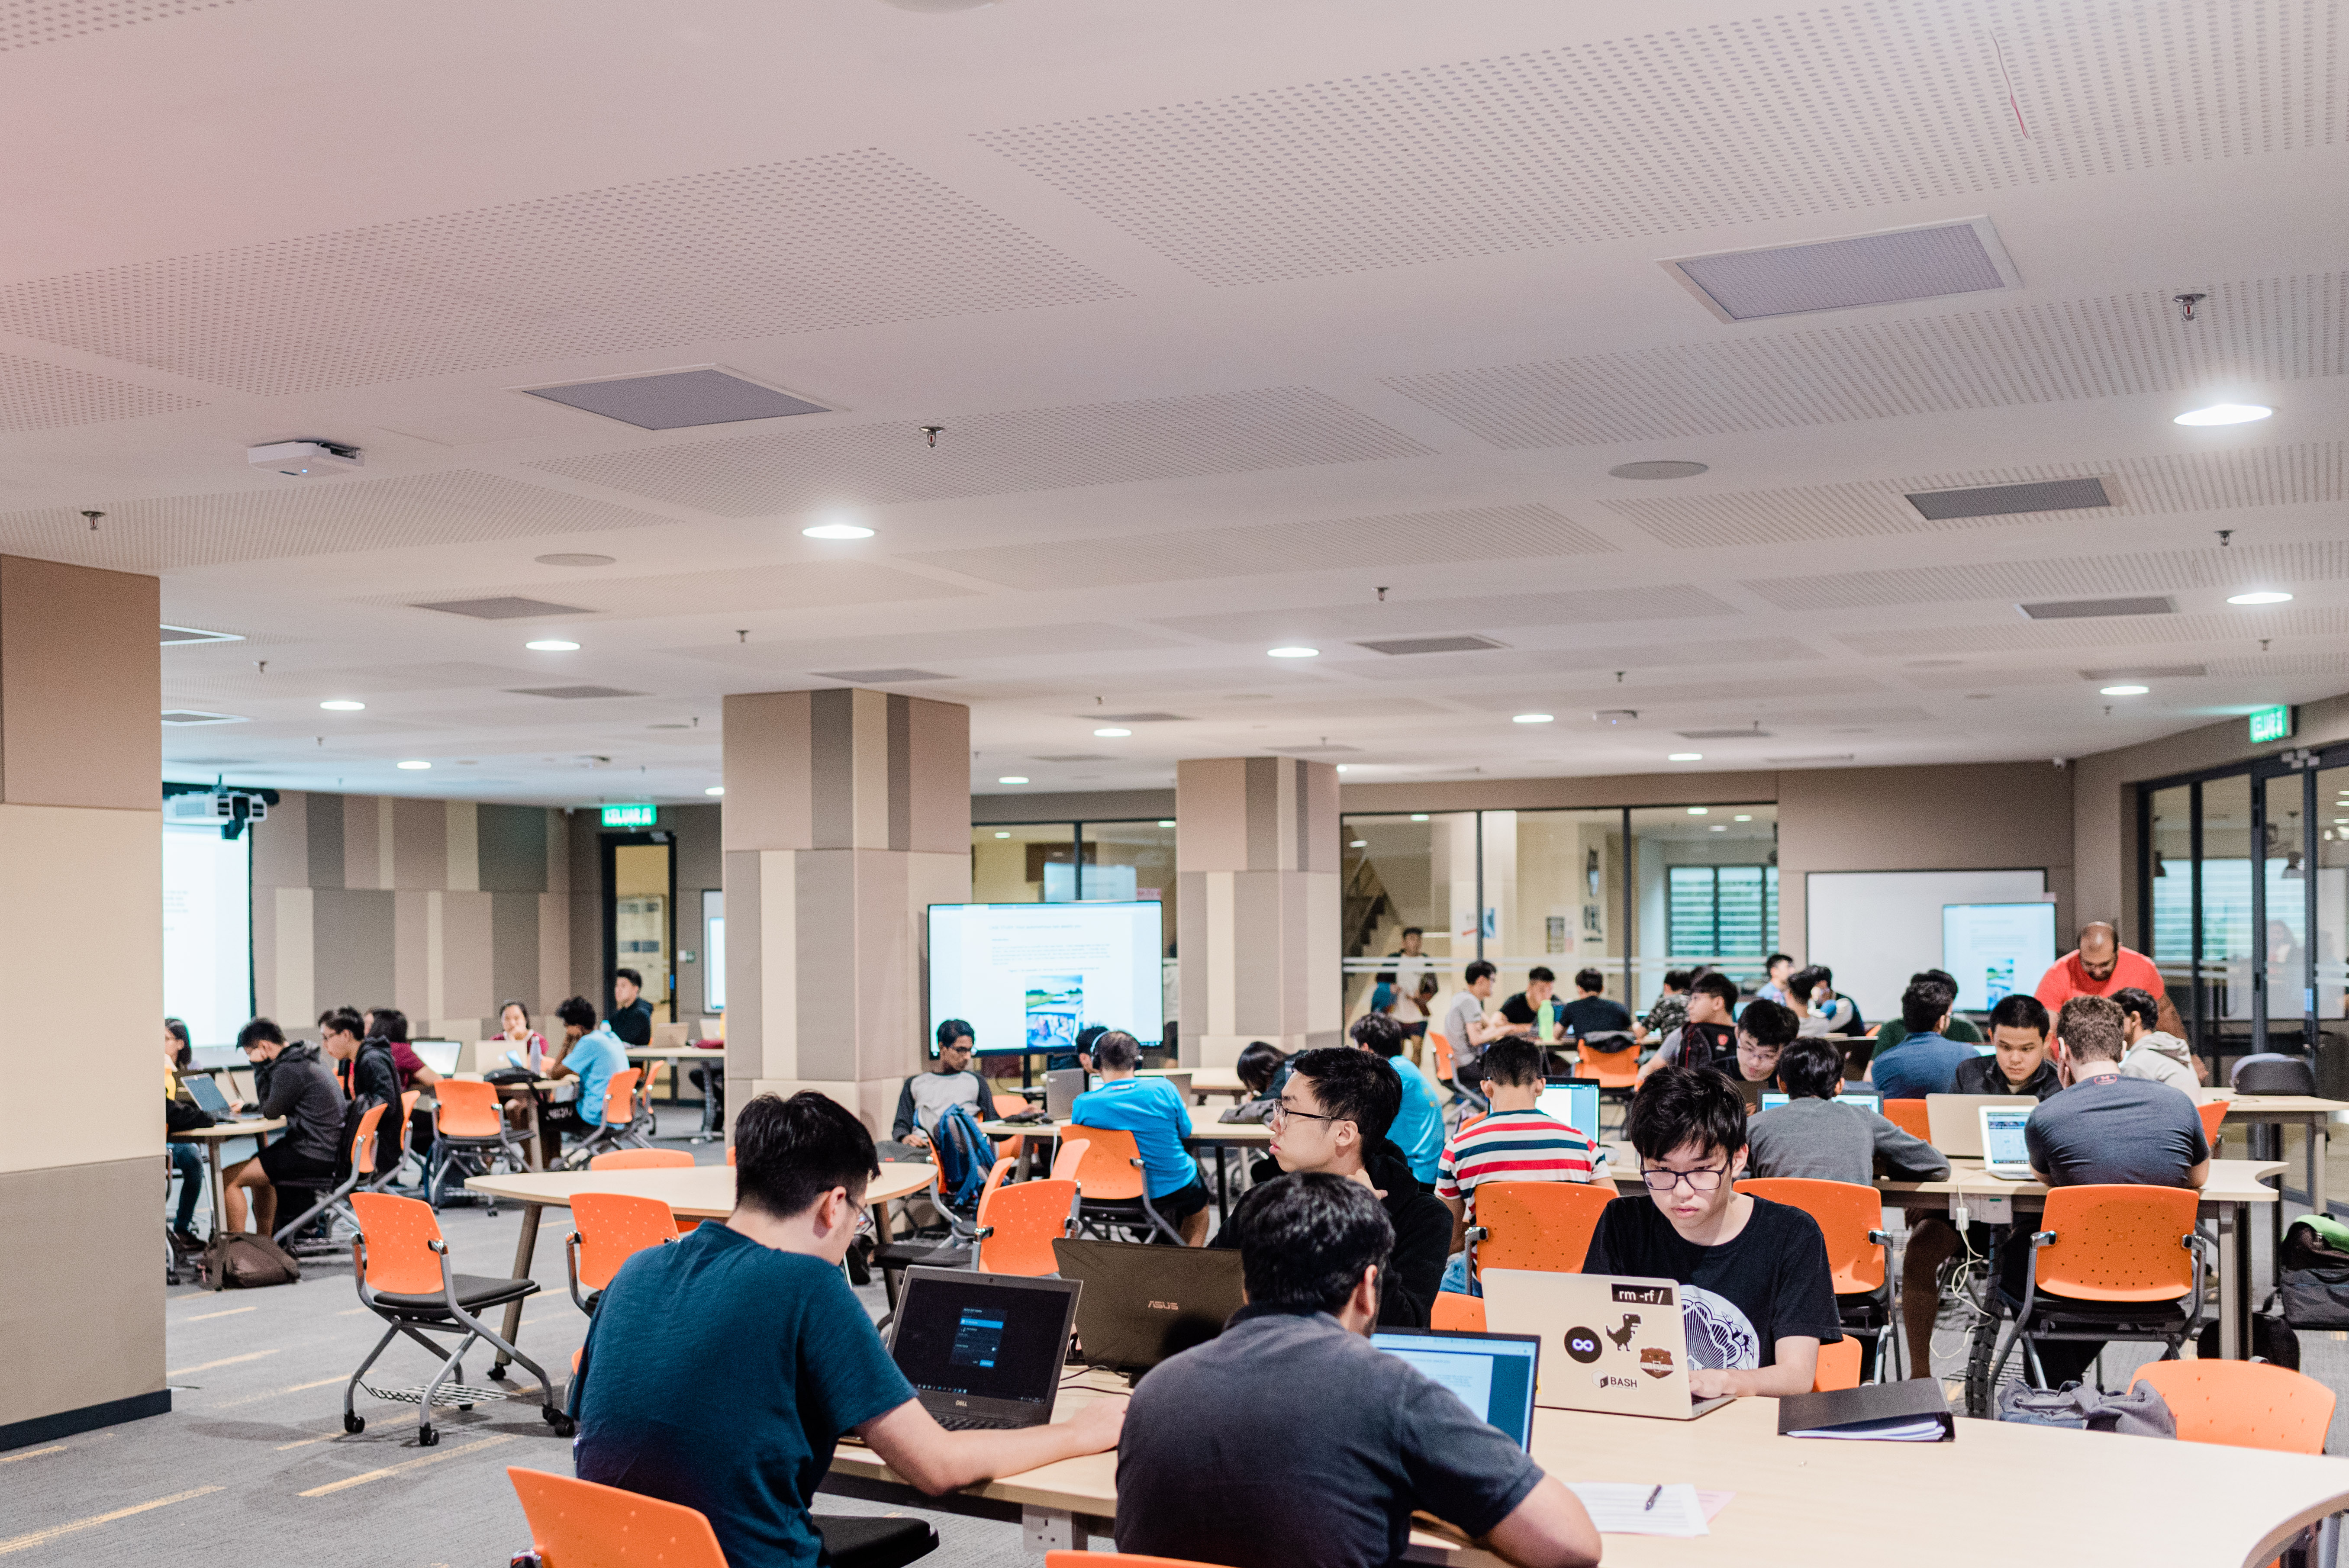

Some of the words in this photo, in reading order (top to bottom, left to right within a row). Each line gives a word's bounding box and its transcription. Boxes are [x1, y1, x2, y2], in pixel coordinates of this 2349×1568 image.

[1619, 1291, 1636, 1301] rm
[1639, 1290, 1654, 1302] -rf
[1148, 1301, 1179, 1310] ASUS
[1610, 1377, 1637, 1388] BASH
